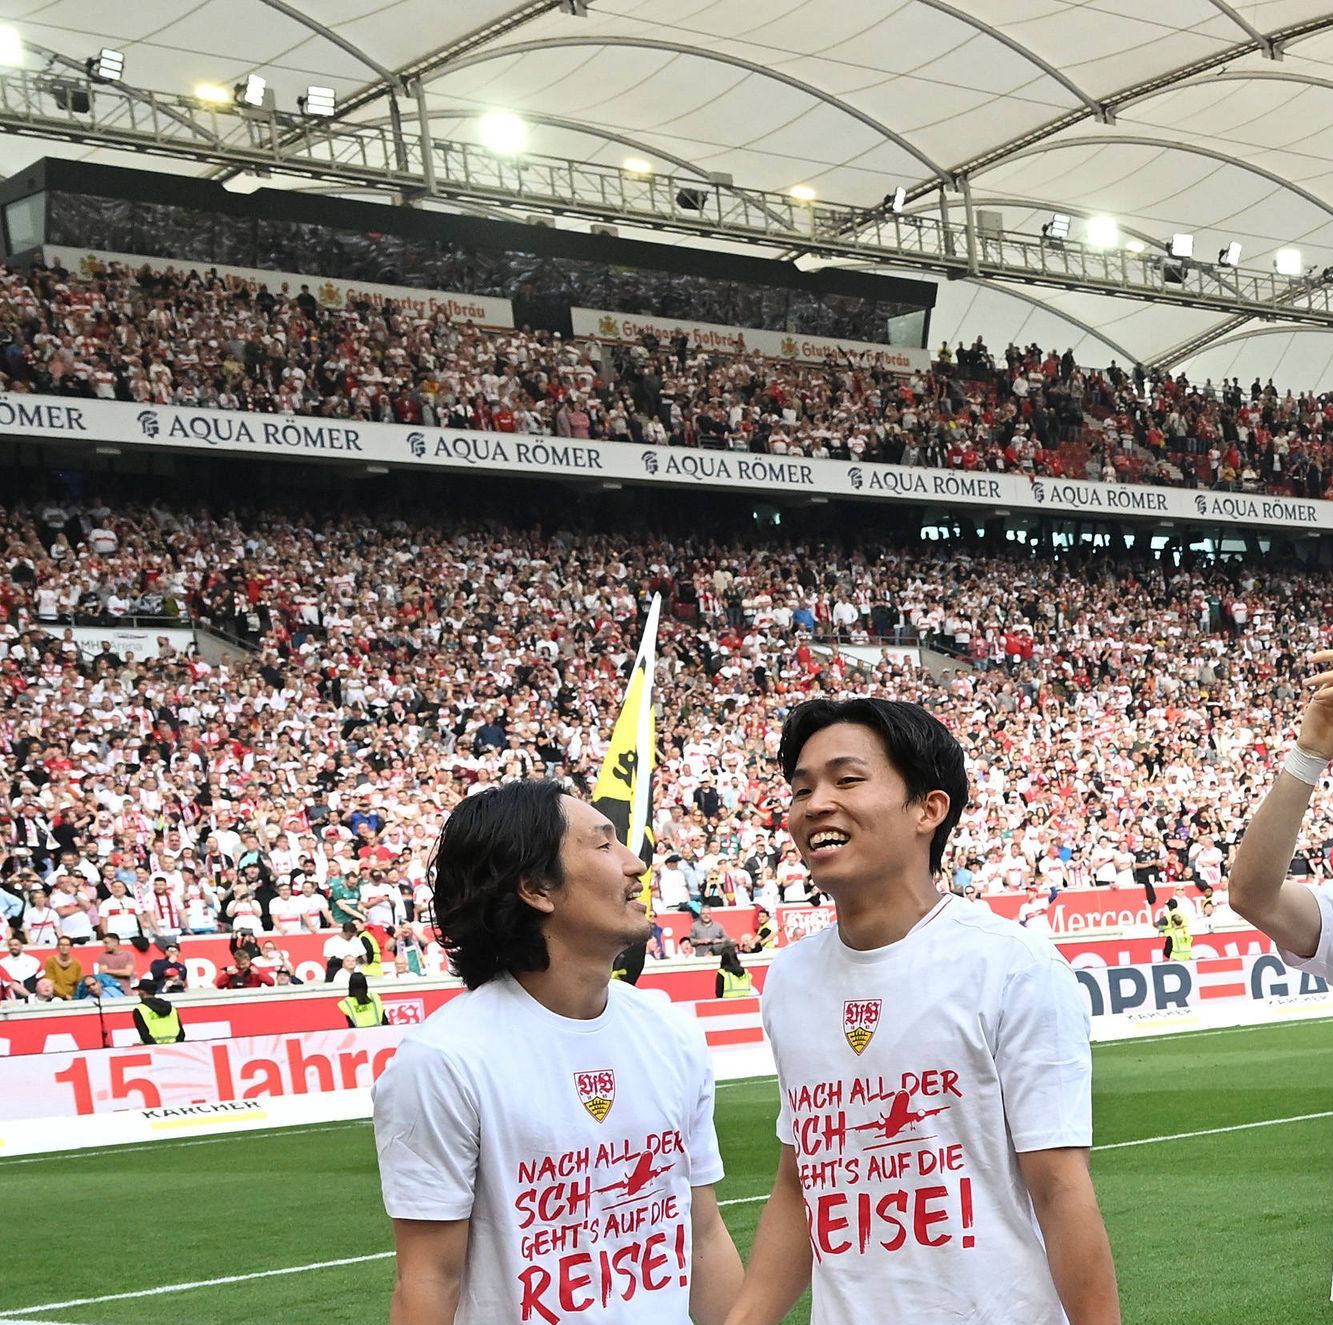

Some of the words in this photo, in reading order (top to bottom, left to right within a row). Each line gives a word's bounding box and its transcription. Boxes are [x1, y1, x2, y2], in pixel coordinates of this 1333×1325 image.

[0, 397, 86, 431] ÖMER
[169, 415, 255, 444] AQUA
[264, 418, 363, 451] RÖMER
[434, 437, 507, 463] AQUA
[516, 440, 602, 468] RÖMER
[666, 455, 732, 480] AQUA
[739, 457, 814, 484] RÖMER
[869, 470, 928, 494] AQUA
[934, 473, 1001, 498] RÖMER
[1050, 486, 1101, 507] AQUA
[1107, 487, 1168, 510] RÖMER
[1211, 498, 1258, 519] AQUA
[1262, 500, 1317, 521] RÖMER
[850, 1076, 895, 1103] ALL
[902, 1070, 962, 1097] DER
[519, 1147, 589, 1183] NACH
[595, 1140, 640, 1168] ALL
[647, 1130, 685, 1154] DER
[801, 1158, 858, 1190] EHT'S
[867, 1153, 911, 1188] AUF
[918, 1144, 963, 1176] DIE
[521, 1220, 599, 1261] GEHT'S
[604, 1206, 648, 1238] AUF
[651, 1196, 679, 1224] DIE
[517, 1224, 687, 1325] REISE!
